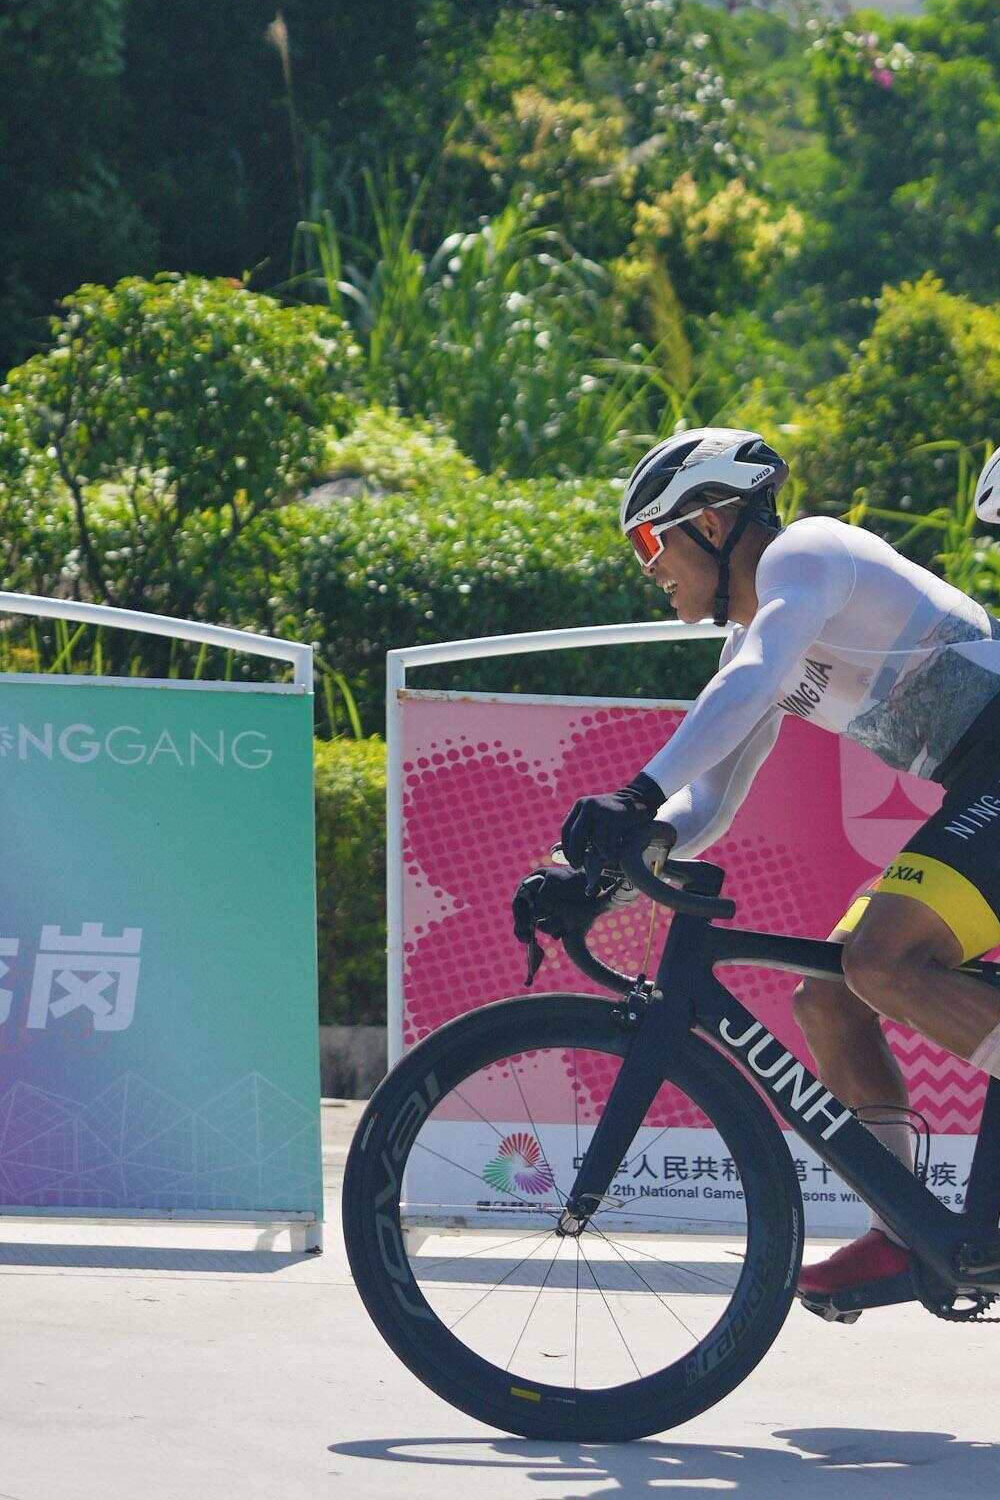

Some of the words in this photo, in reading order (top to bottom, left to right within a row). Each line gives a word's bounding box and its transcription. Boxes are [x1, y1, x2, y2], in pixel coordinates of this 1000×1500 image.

[777, 682, 821, 717] NING
[805, 658, 832, 693] XIA
[0, 922, 143, 1032] 岗
[718, 1017, 853, 1141] JUNH
[641, 1184, 698, 1198] National
[703, 1188, 744, 1199] Game
